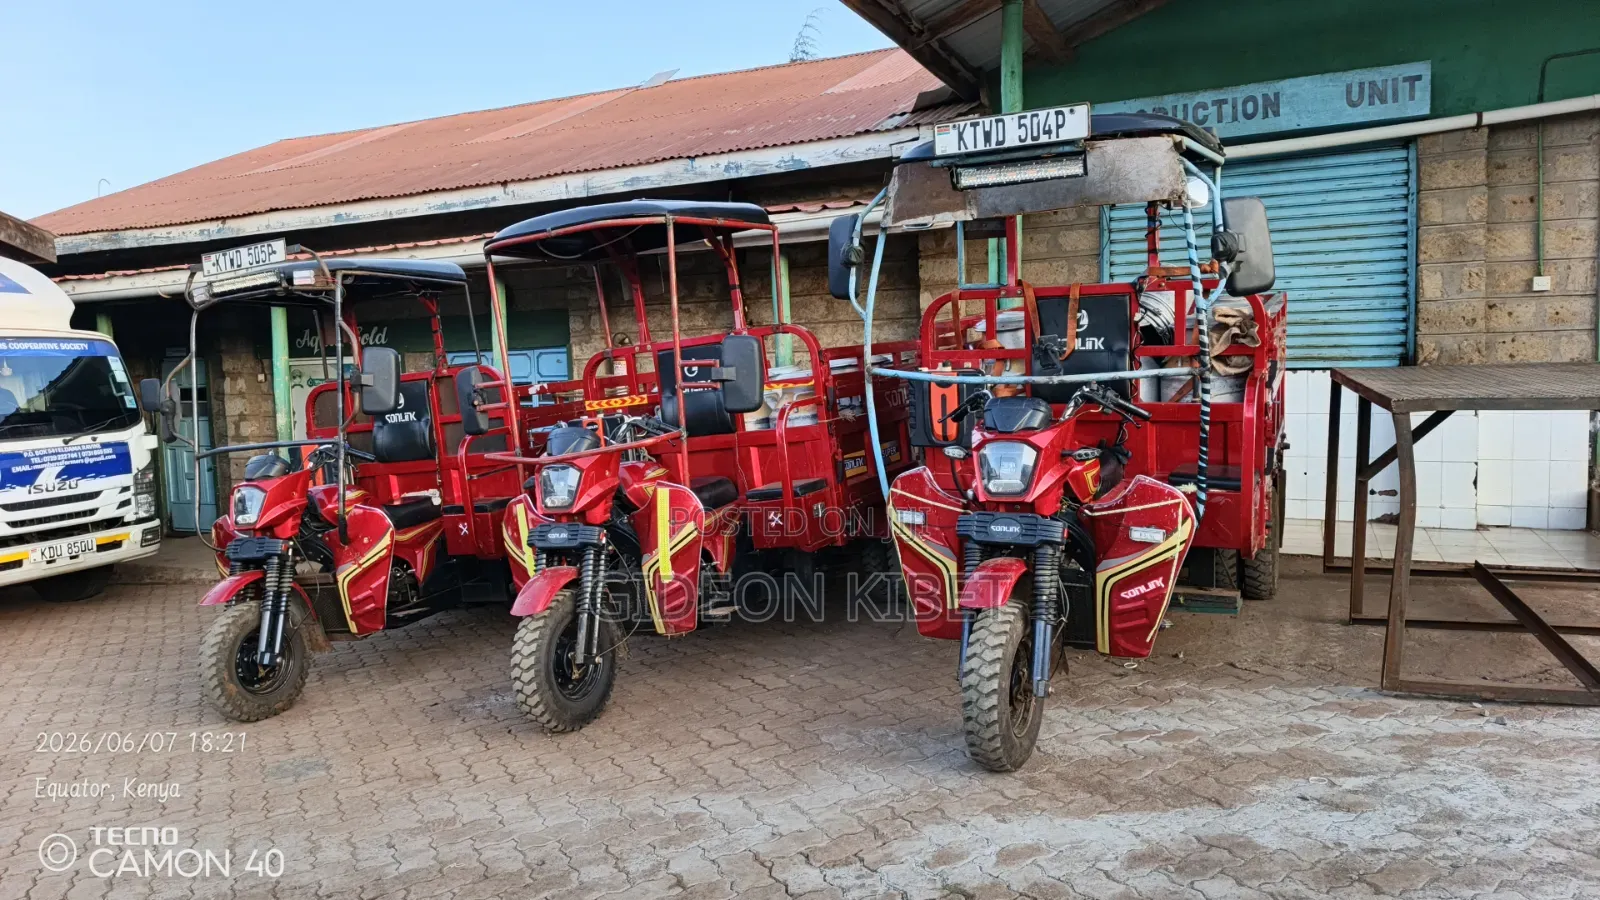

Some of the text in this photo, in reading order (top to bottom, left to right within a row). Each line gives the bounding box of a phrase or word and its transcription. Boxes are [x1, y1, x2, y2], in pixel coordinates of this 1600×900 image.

[1345, 74, 1423, 108] UNIT
[957, 109, 1066, 151] KTWD 504P
[214, 243, 274, 273] KTWD 505P
[355, 326, 388, 345] old
[8, 342, 59, 351] COOPERATIVE
[60, 342, 89, 351] SOCIETY
[384, 411, 417, 424] SONLINK
[35, 449, 48, 457] BOX
[28, 480, 78, 495] ISUZU
[990, 525, 1021, 533] SONLINK
[41, 539, 94, 560] KDU 850U
[1120, 576, 1165, 599] SONLINK
